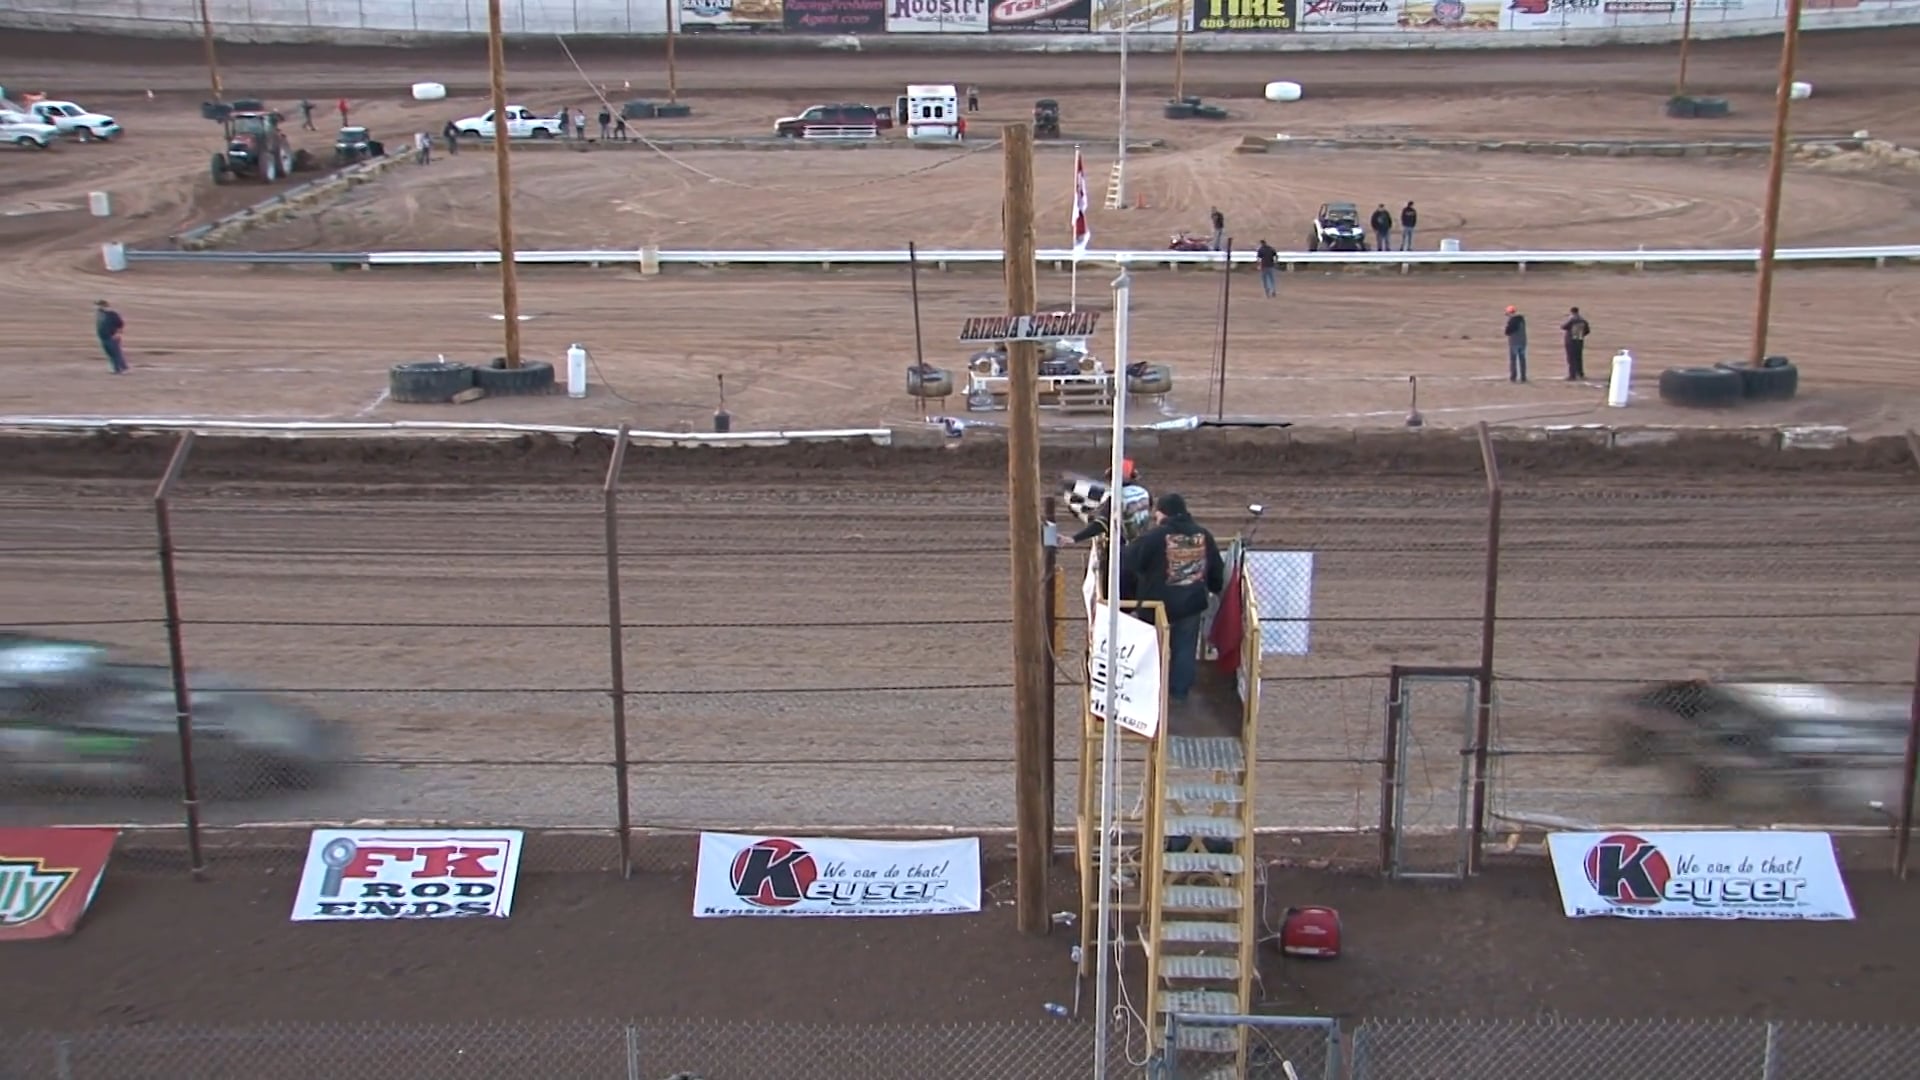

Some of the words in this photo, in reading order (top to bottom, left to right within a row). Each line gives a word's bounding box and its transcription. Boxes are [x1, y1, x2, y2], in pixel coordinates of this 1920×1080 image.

[961, 315, 1020, 340] ARIZONA
[1026, 311, 1100, 337] SPEEDWAY
[341, 846, 499, 878] FK
[823, 861, 847, 878] We
[853, 869, 878, 878] can
[884, 863, 900, 878] do
[906, 859, 950, 879] that!
[1595, 842, 1807, 906] Keyser
[1676, 855, 1700, 874] We
[1706, 863, 1731, 874] can
[1737, 855, 1753, 874] do
[1761, 855, 1802, 875] that!
[736, 845, 948, 906] Keyser
[359, 882, 496, 898] ROD
[314, 902, 492, 916] ENDS
